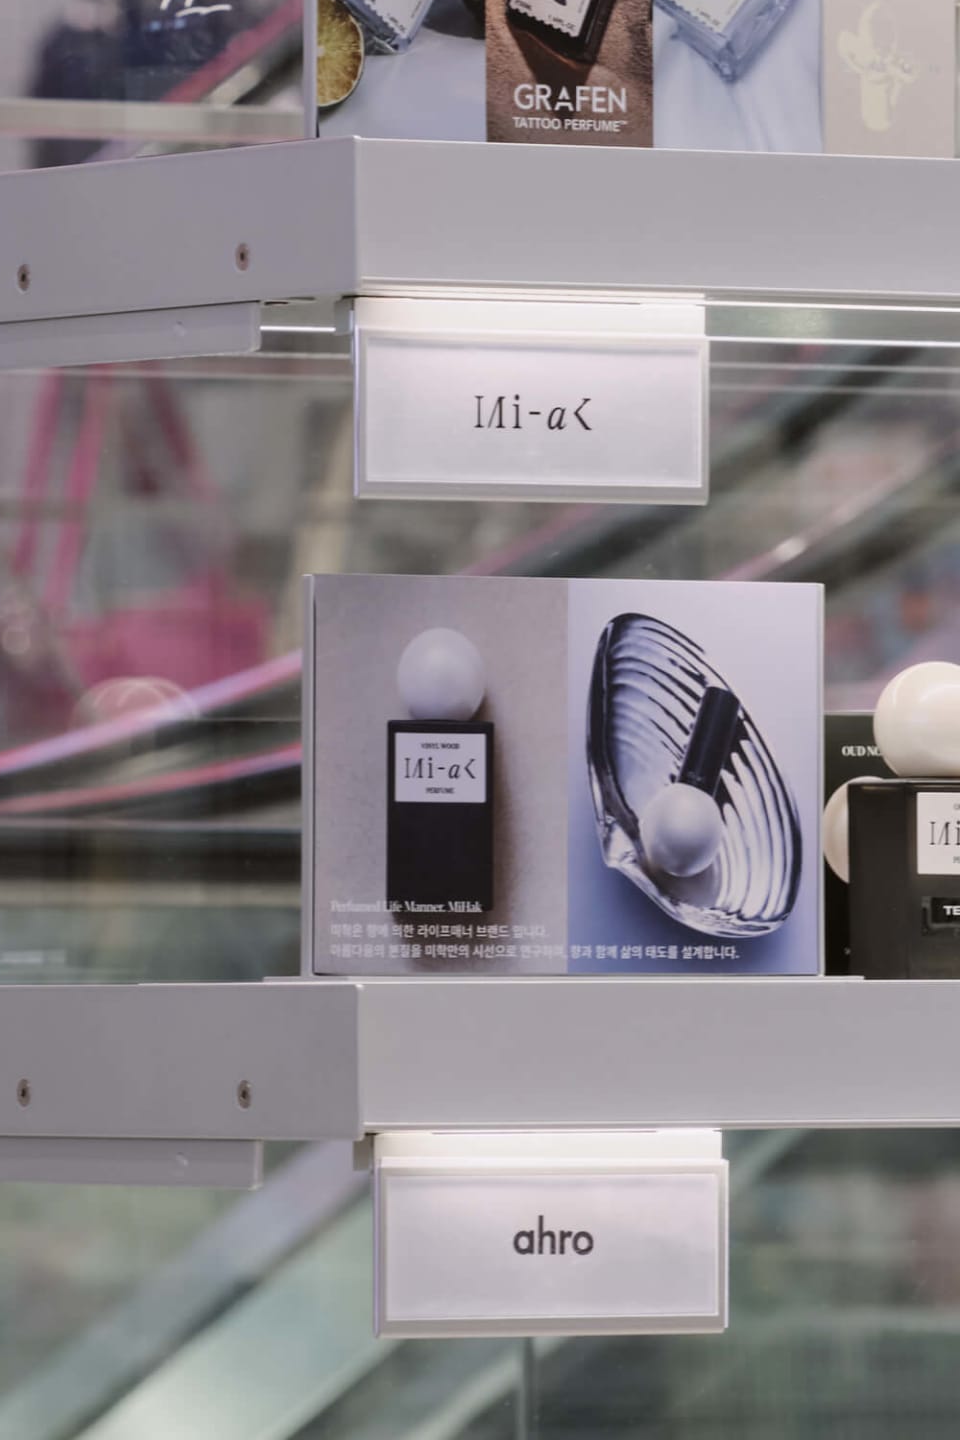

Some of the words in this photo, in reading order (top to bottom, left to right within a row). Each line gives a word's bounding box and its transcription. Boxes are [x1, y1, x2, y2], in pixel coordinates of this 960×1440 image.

[513, 84, 628, 113] GRAFEN
[512, 117, 561, 130] TATTOO
[841, 745, 866, 757] OUD
[329, 900, 382, 912] Perfumed
[383, 900, 403, 912] Life
[476, 924, 510, 938] 브랜드
[425, 944, 470, 959] 미학만의
[472, 944, 517, 959] 시선으로
[571, 944, 593, 959] 향과
[621, 944, 642, 959] 삶의
[645, 944, 678, 959] 태도를
[681, 944, 740, 959] 설계합니다.
[513, 1215, 594, 1255] ahro
